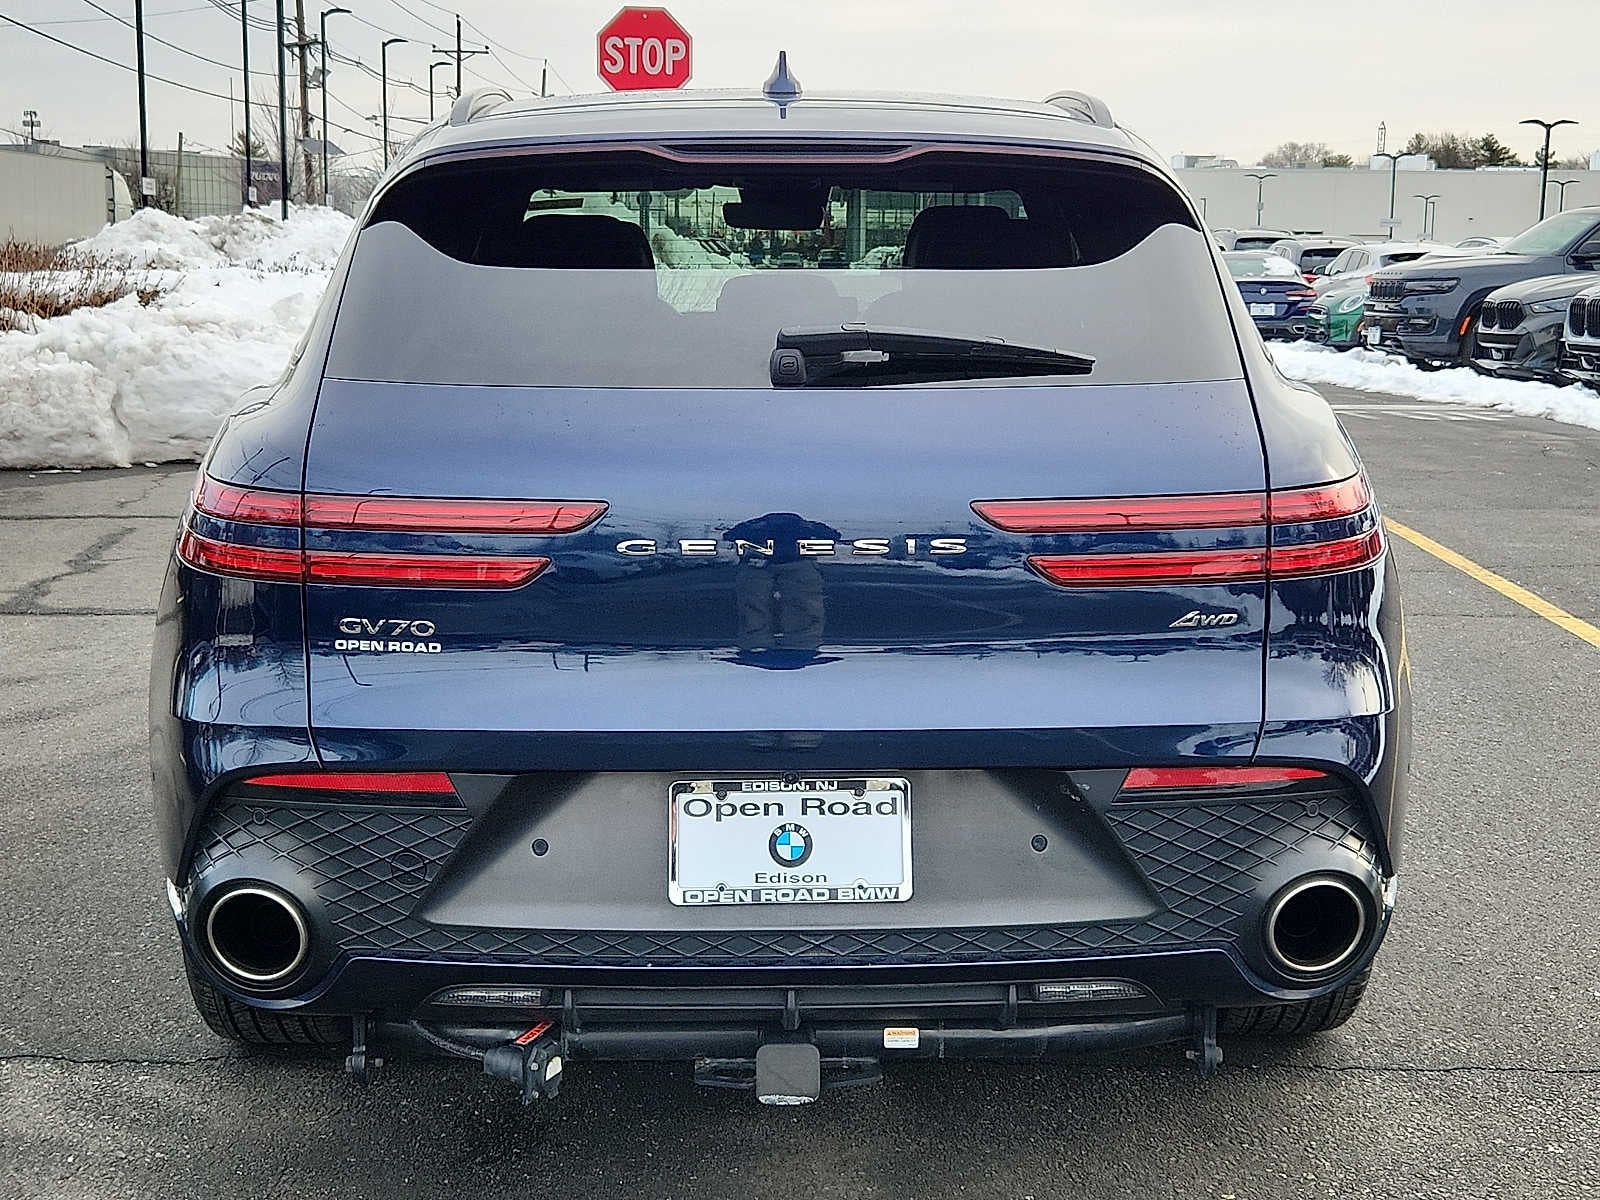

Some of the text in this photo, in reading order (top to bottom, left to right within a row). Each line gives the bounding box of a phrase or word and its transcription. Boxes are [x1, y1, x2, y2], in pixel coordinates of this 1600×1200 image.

[604, 36, 686, 75] STOP
[616, 538, 968, 556] GENESIS
[339, 617, 436, 637] GV70
[334, 639, 442, 653] OPEN ROAD
[816, 780, 838, 791] NJ
[683, 797, 898, 822] Open Road
[773, 823, 809, 837] BMW
[755, 872, 828, 884] Edison
[685, 886, 899, 902] OPEN ROAD BMW
